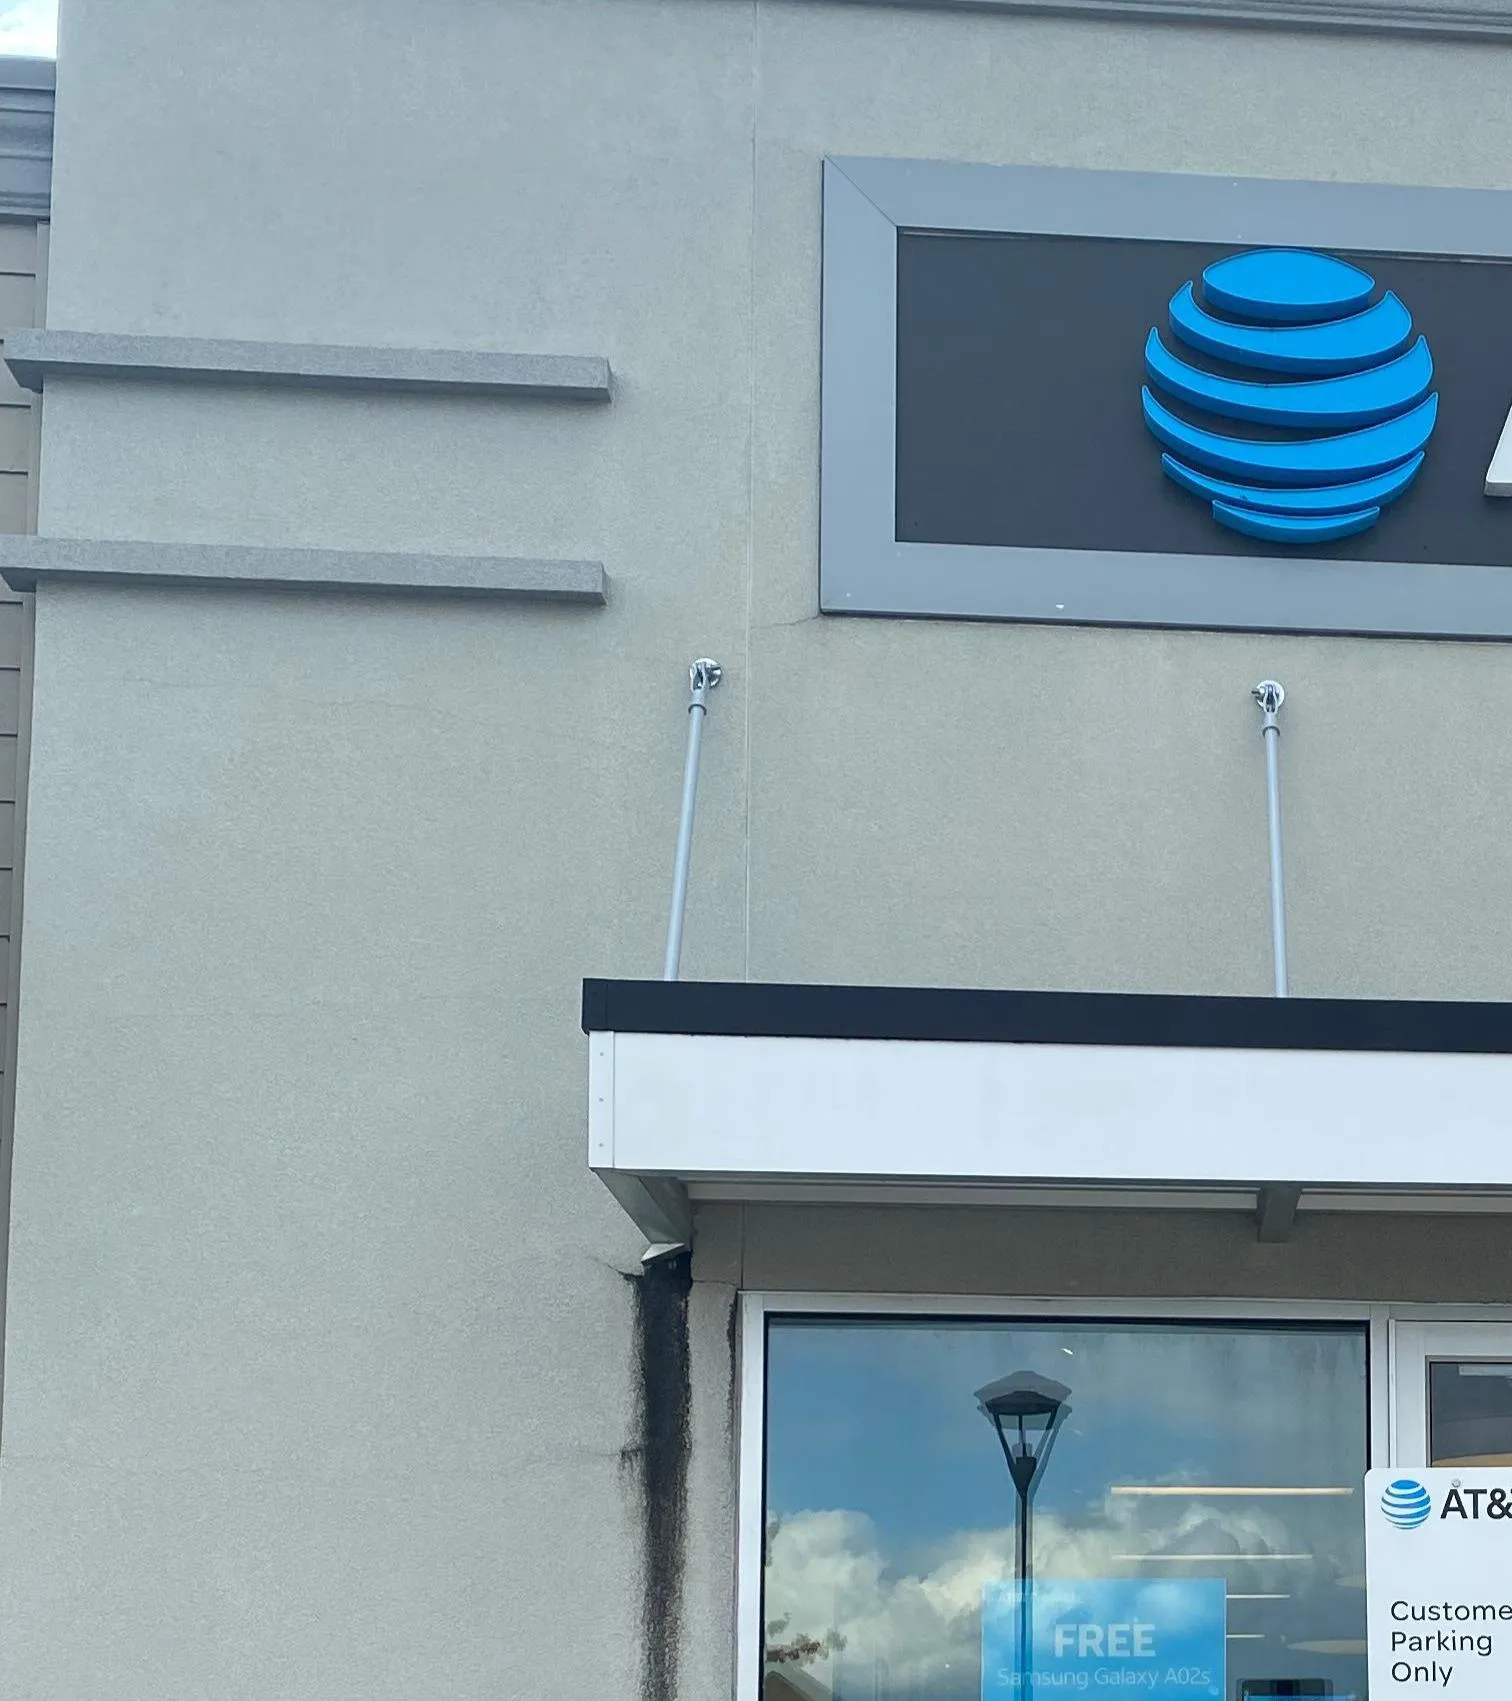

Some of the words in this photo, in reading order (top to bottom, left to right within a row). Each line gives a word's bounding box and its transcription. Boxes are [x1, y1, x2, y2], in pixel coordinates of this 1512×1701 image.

[1054, 1623, 1156, 1658] FREE
[1391, 1629, 1493, 1657] Parking
[997, 1667, 1089, 1690] Samsung
[1094, 1667, 1159, 1690] Galaxy
[1164, 1667, 1211, 1685] A02s
[1391, 1661, 1454, 1687] Only
